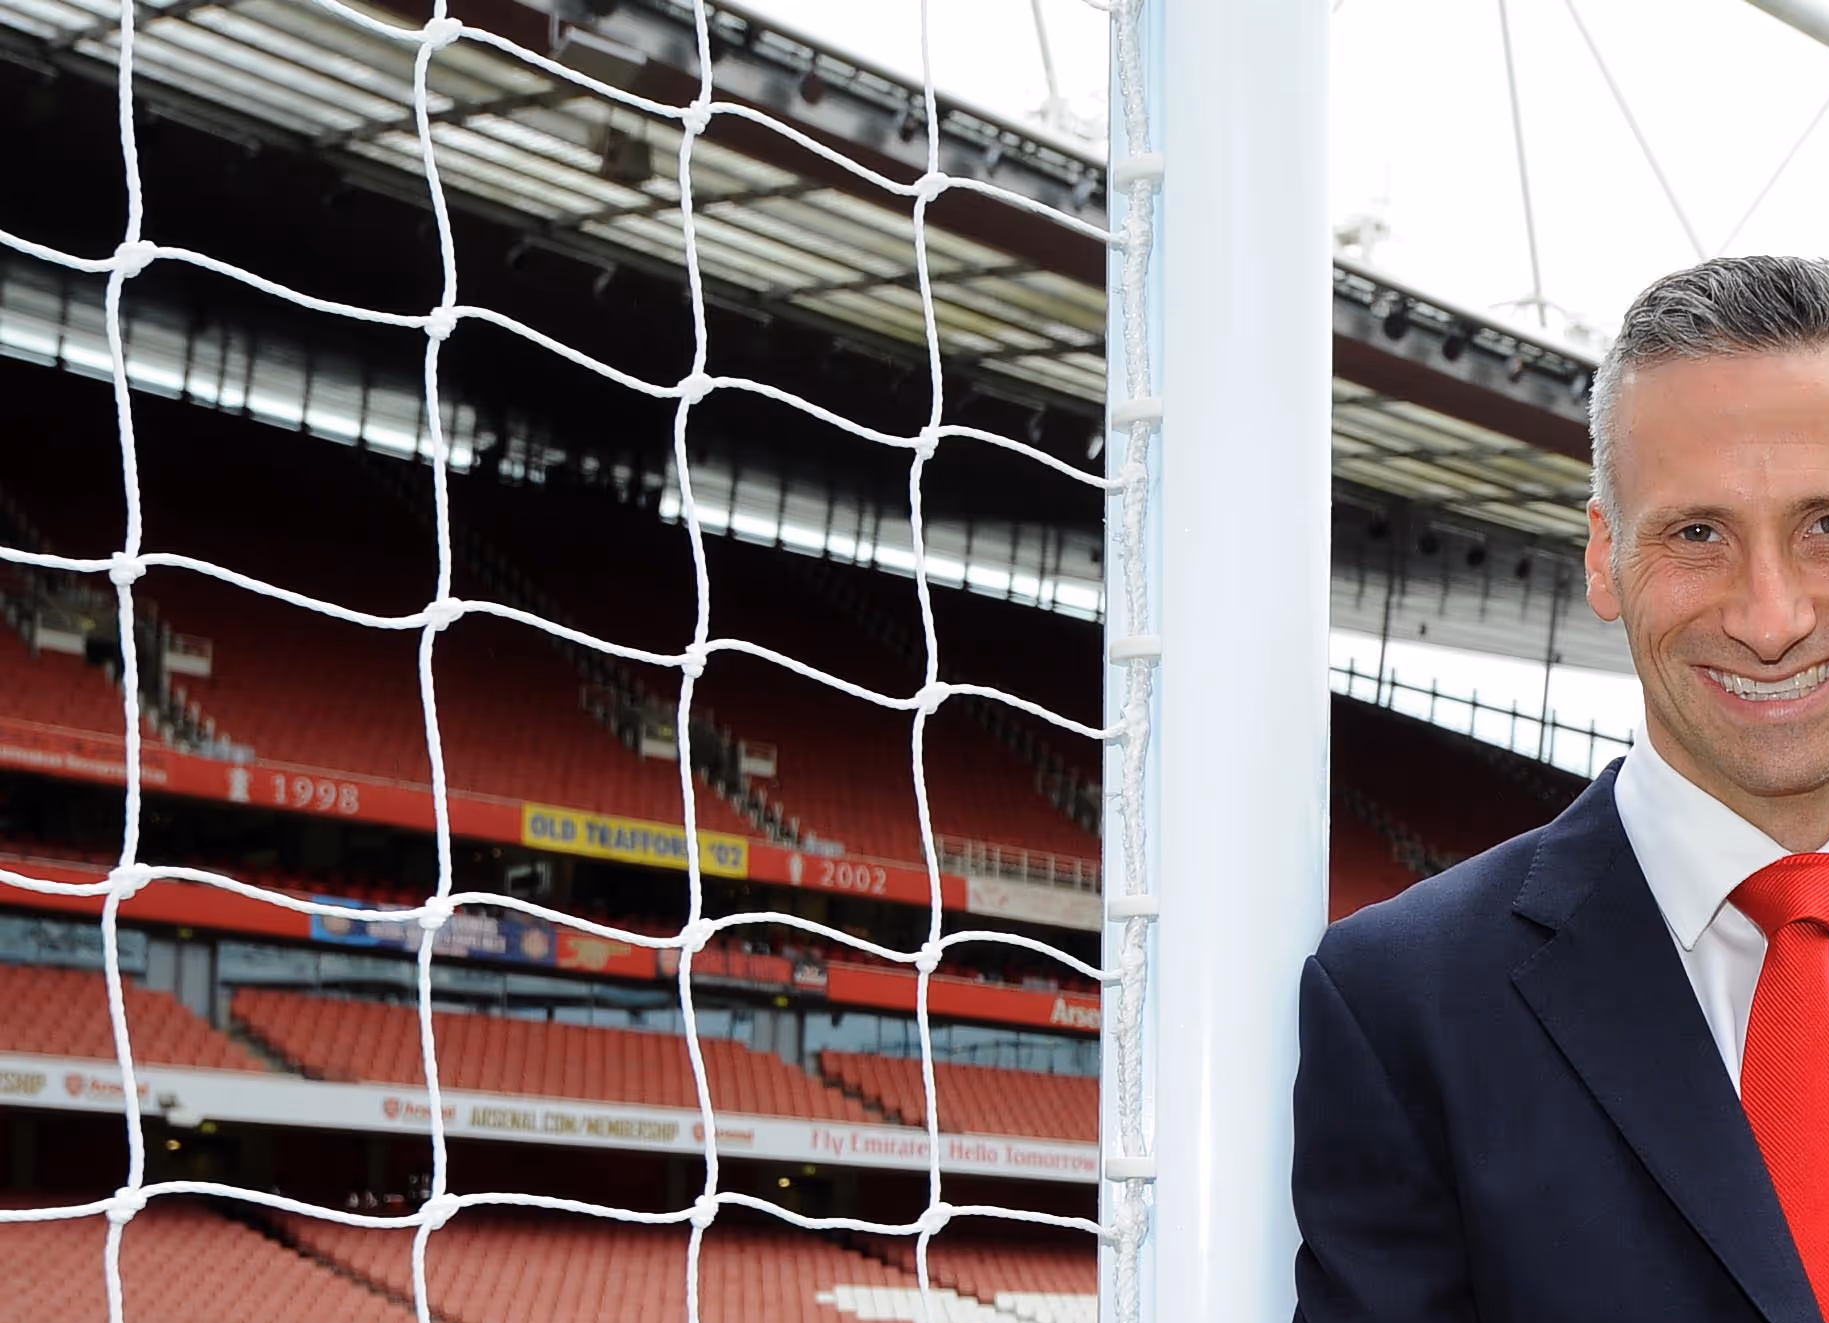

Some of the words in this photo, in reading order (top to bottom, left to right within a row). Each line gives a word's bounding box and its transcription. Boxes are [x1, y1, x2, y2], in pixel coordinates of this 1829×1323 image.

[272, 773, 360, 815] 1998
[530, 813, 576, 842] OLD
[584, 820, 692, 861] TRAFFOR
[819, 860, 887, 895] 2002
[811, 1128, 844, 1159] Fly
[851, 1132, 930, 1158] Emirate
[949, 1138, 998, 1164] Hello
[1003, 1144, 1096, 1171] Tomorrow
